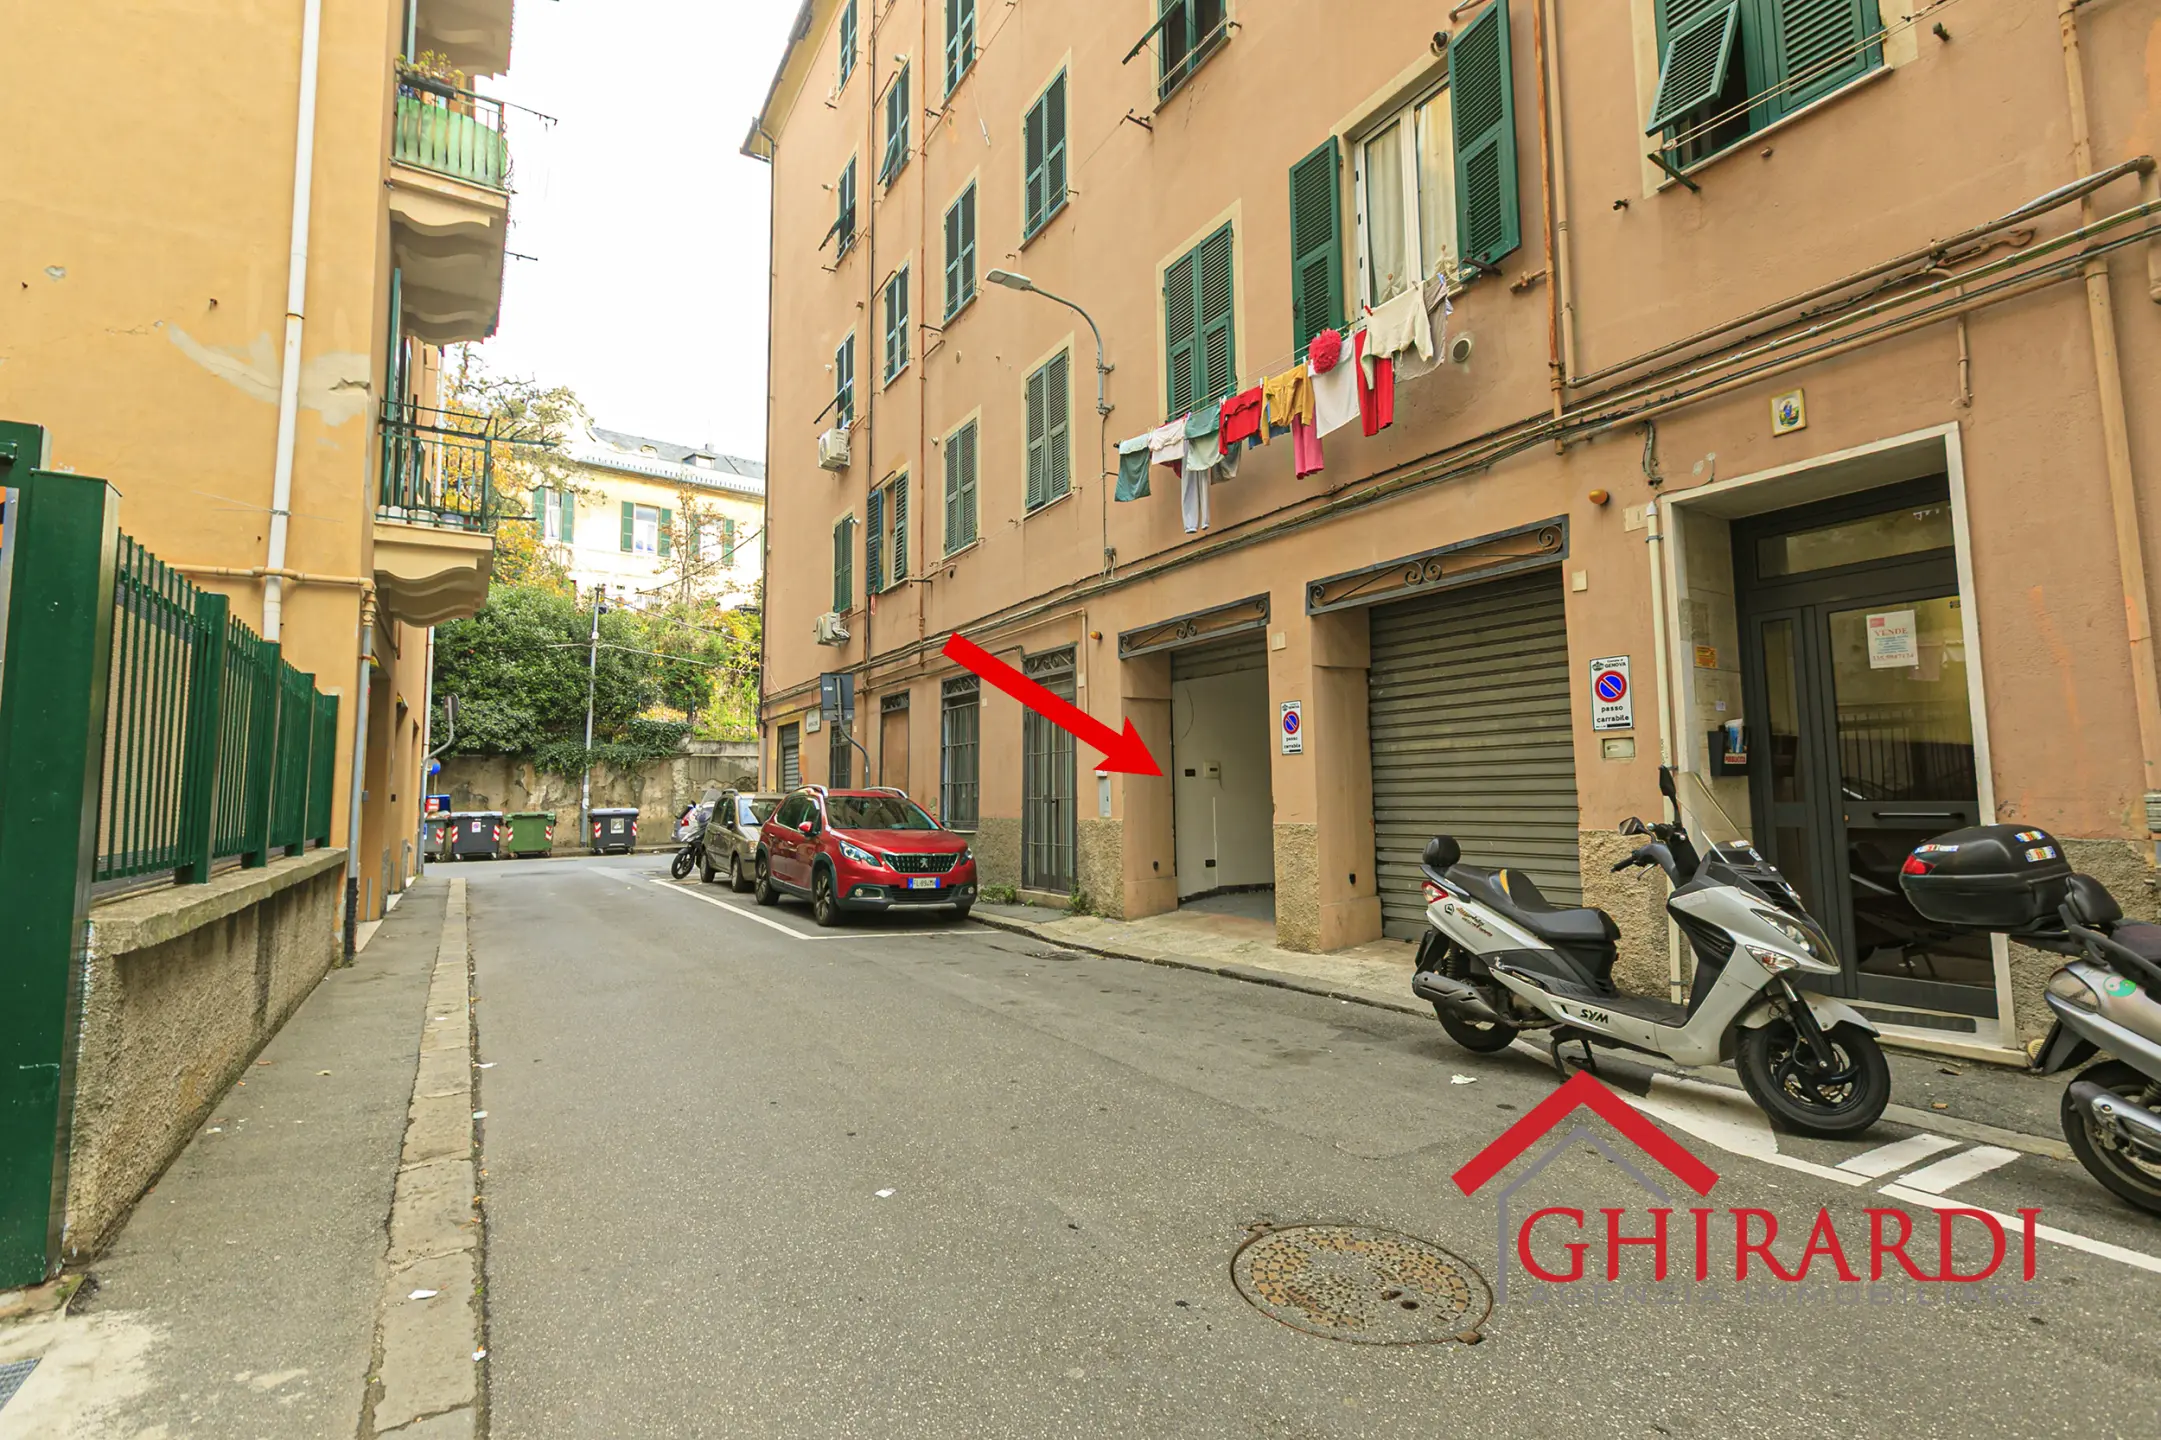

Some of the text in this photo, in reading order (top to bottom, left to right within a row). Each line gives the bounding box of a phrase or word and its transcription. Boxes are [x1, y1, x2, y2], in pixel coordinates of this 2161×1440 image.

[1874, 627, 1908, 637] VENDE
[1601, 705, 1624, 713] passo
[1596, 714, 1630, 723] carrabile
[1580, 1009, 1608, 1024] SYM
